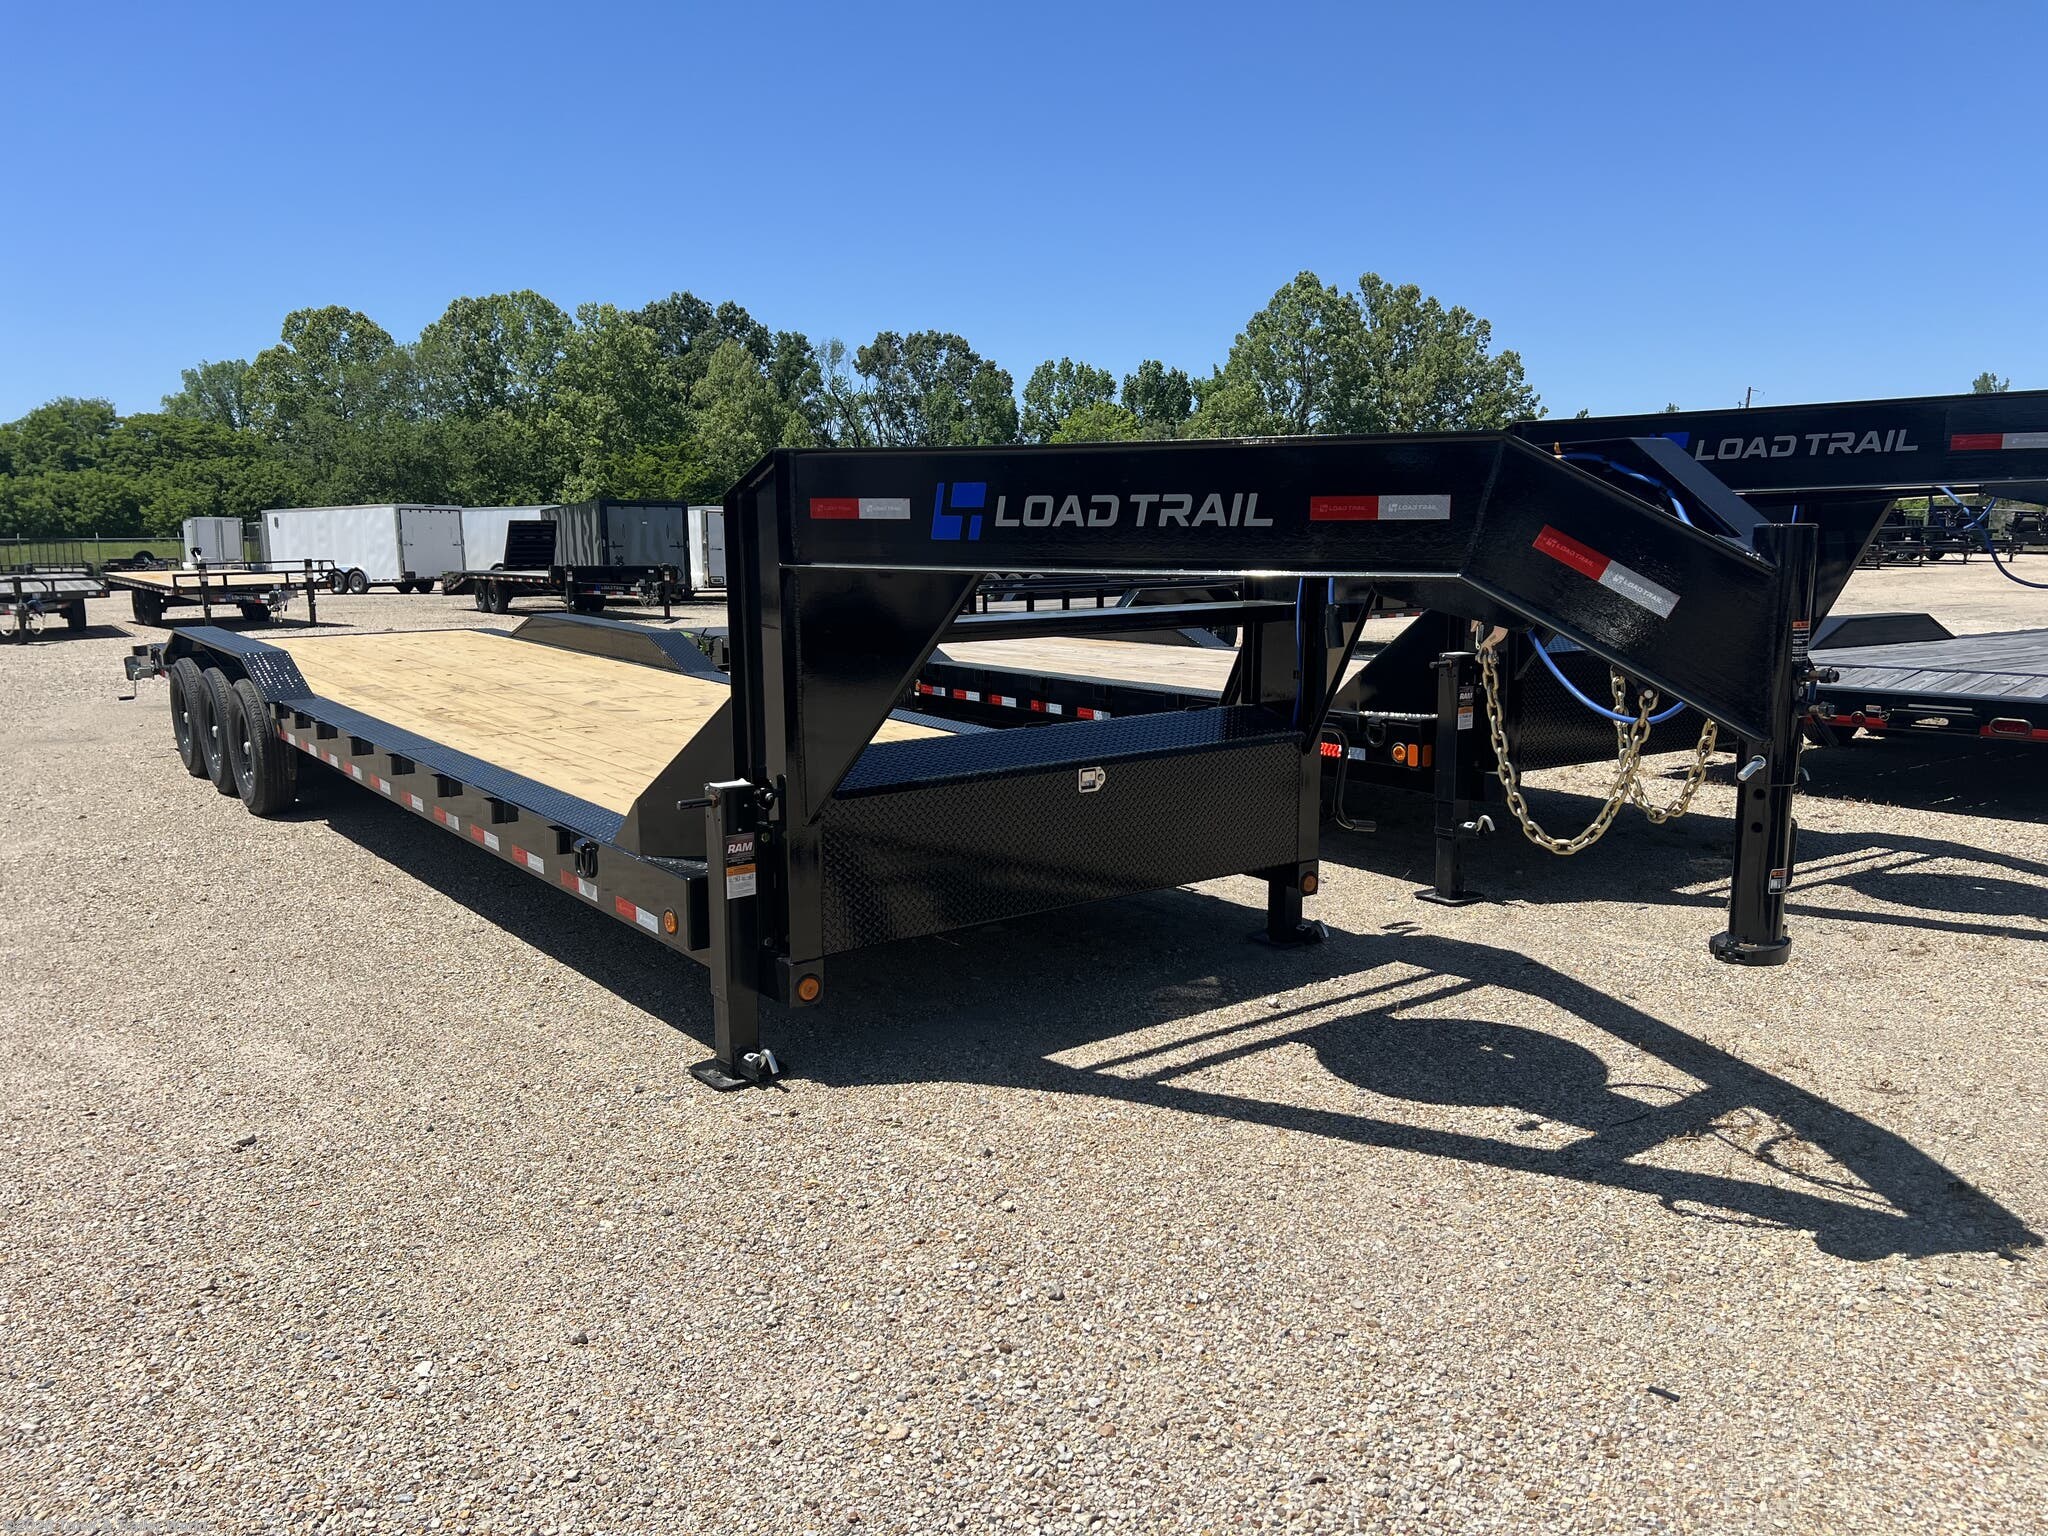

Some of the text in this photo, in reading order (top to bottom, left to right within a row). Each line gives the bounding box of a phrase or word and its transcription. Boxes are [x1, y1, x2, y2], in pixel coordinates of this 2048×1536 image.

[1695, 428, 1919, 460] LOAD TRAIL
[995, 493, 1274, 527] LOAD TRAIL
[1624, 578, 1644, 593] LOAD
[727, 841, 752, 854] RAM
